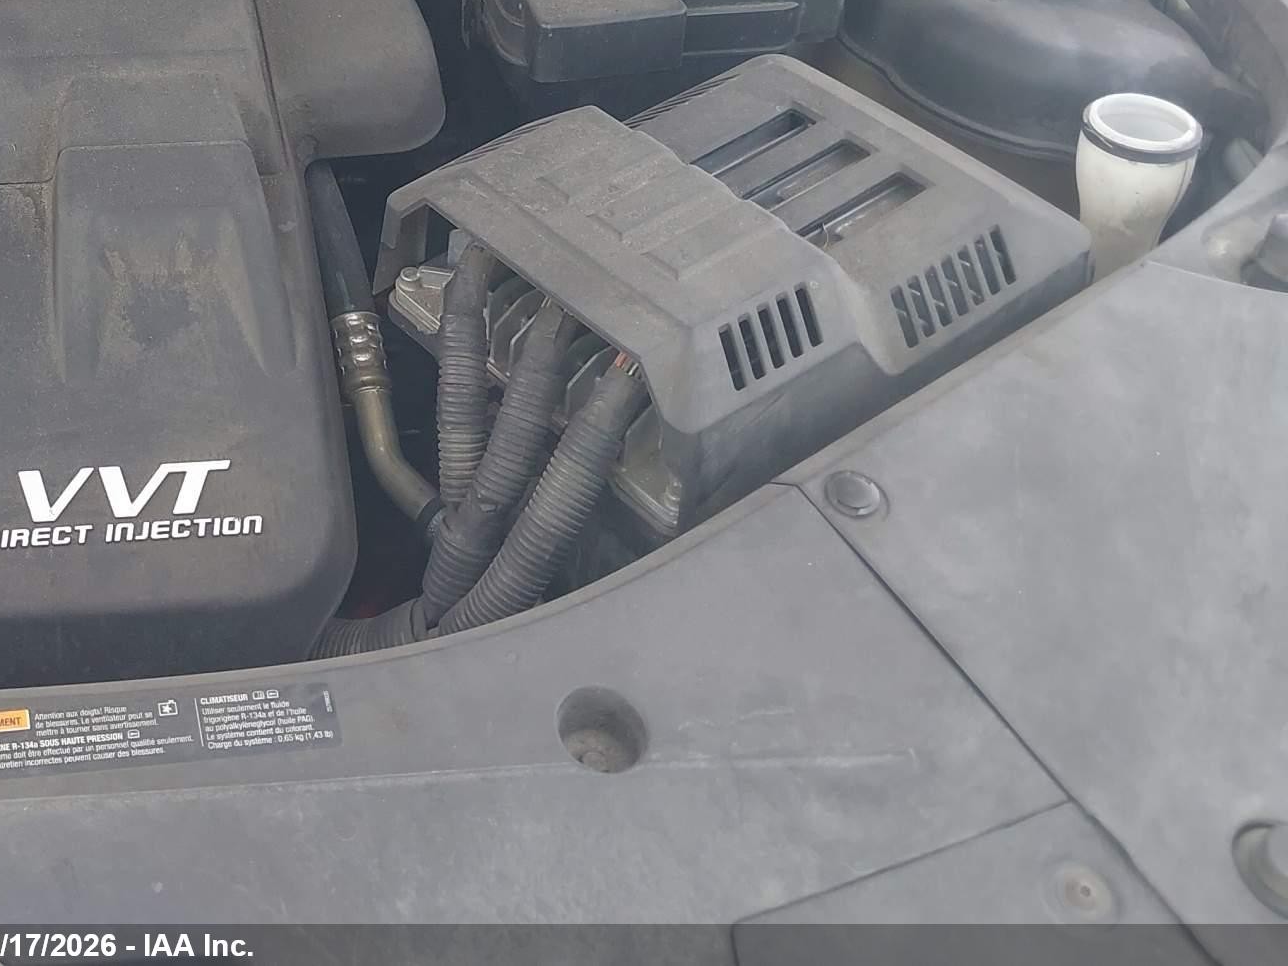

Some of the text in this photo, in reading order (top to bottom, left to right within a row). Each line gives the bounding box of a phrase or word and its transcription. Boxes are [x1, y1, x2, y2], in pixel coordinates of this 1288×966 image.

[18, 460, 231, 523] VVT
[105, 515, 263, 543] INJECTION
[200, 693, 248, 704] CLIMATISEUR
[202, 700, 290, 715] Utiliser seulement le fluide
[35, 712, 64, 721] Attention
[104, 705, 127, 714] Risque
[36, 721, 45, 729] de
[46, 718, 79, 727] blessures.
[92, 714, 126, 723] ventilateur
[128, 712, 143, 721] peut
[276, 709, 285, 717] de
[277, 717, 296, 726] (huile
[36, 728, 58, 737] mettre
[66, 724, 90, 733] tourner
[92, 723, 108, 731] sans
[110, 719, 159, 729] avertissement.
[207, 733, 215, 741] Le
[246, 727, 273, 737] contient
[275, 726, 284, 734] du
[285, 723, 315, 733] colorant.
[12, 740, 39, 750] R-134a
[40, 739, 59, 748] SOUS
[61, 735, 85, 745] HAUTE
[87, 732, 123, 743] PRESSION
[13, 751, 26, 759] doit
[72, 745, 84, 755] par
[96, 742, 129, 752] personnel
[157, 735, 194, 745] seulement.
[208, 740, 232, 750] Charge
[234, 738, 242, 747] du
[295, 733, 304, 742] kg
[324, 730, 334, 739] lb)
[24, 757, 62, 767] incorrectes
[64, 754, 91, 764] peuvent
[93, 752, 115, 760] causer
[117, 749, 130, 757] des
[132, 746, 165, 756] blessures.
